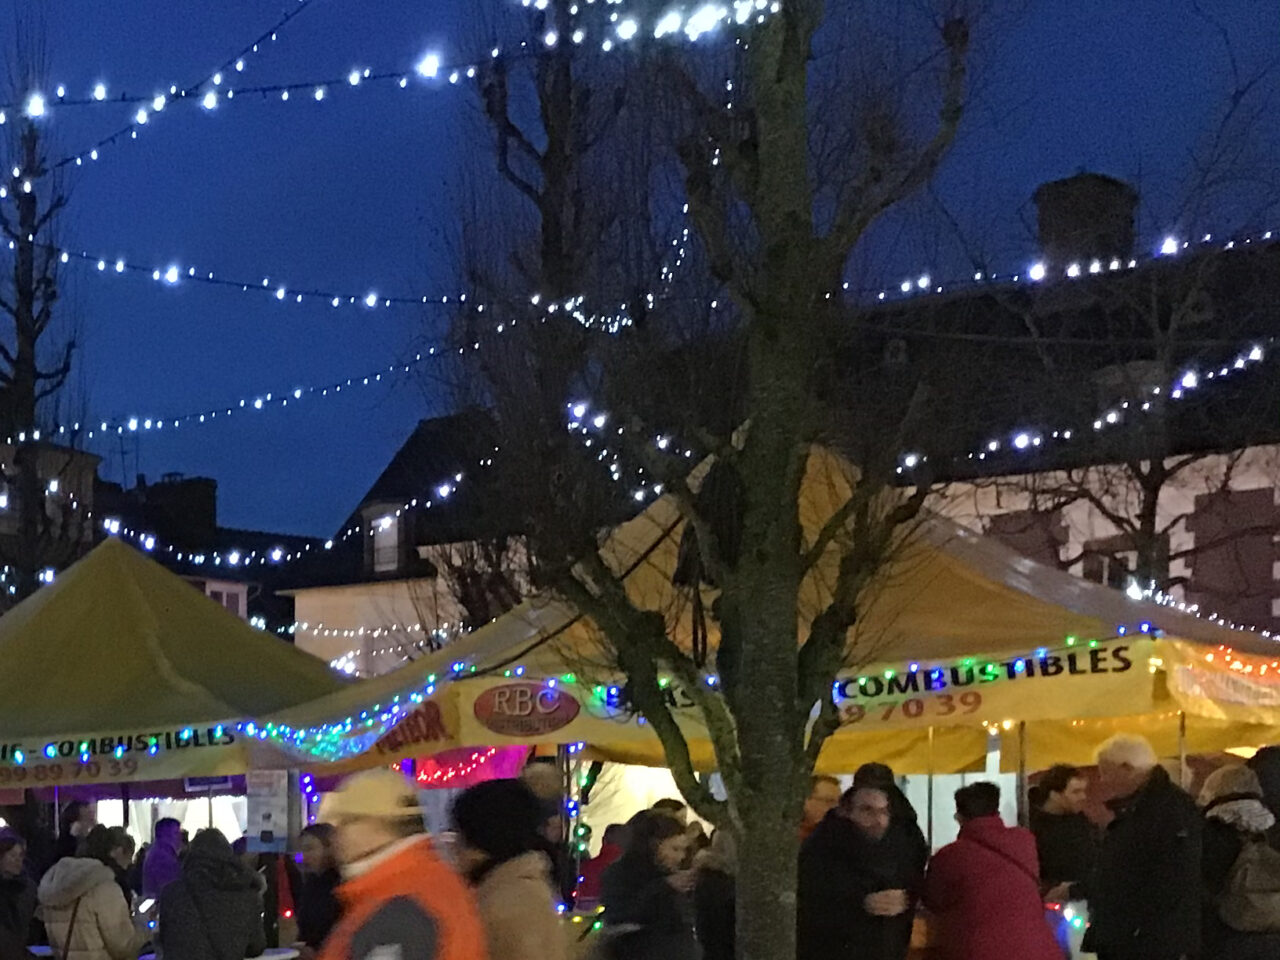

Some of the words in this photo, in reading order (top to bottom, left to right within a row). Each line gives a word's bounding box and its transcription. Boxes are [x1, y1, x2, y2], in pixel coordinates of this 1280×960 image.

[835, 646, 1133, 700] COMBUSTIBLES
[492, 687, 561, 717] RBC
[880, 699, 925, 720] 70
[935, 691, 983, 716] 39
[45, 726, 235, 757] COMBUSTIBLES
[35, 763, 64, 781] 89
[72, 761, 101, 778] 70
[108, 759, 138, 777] 39
